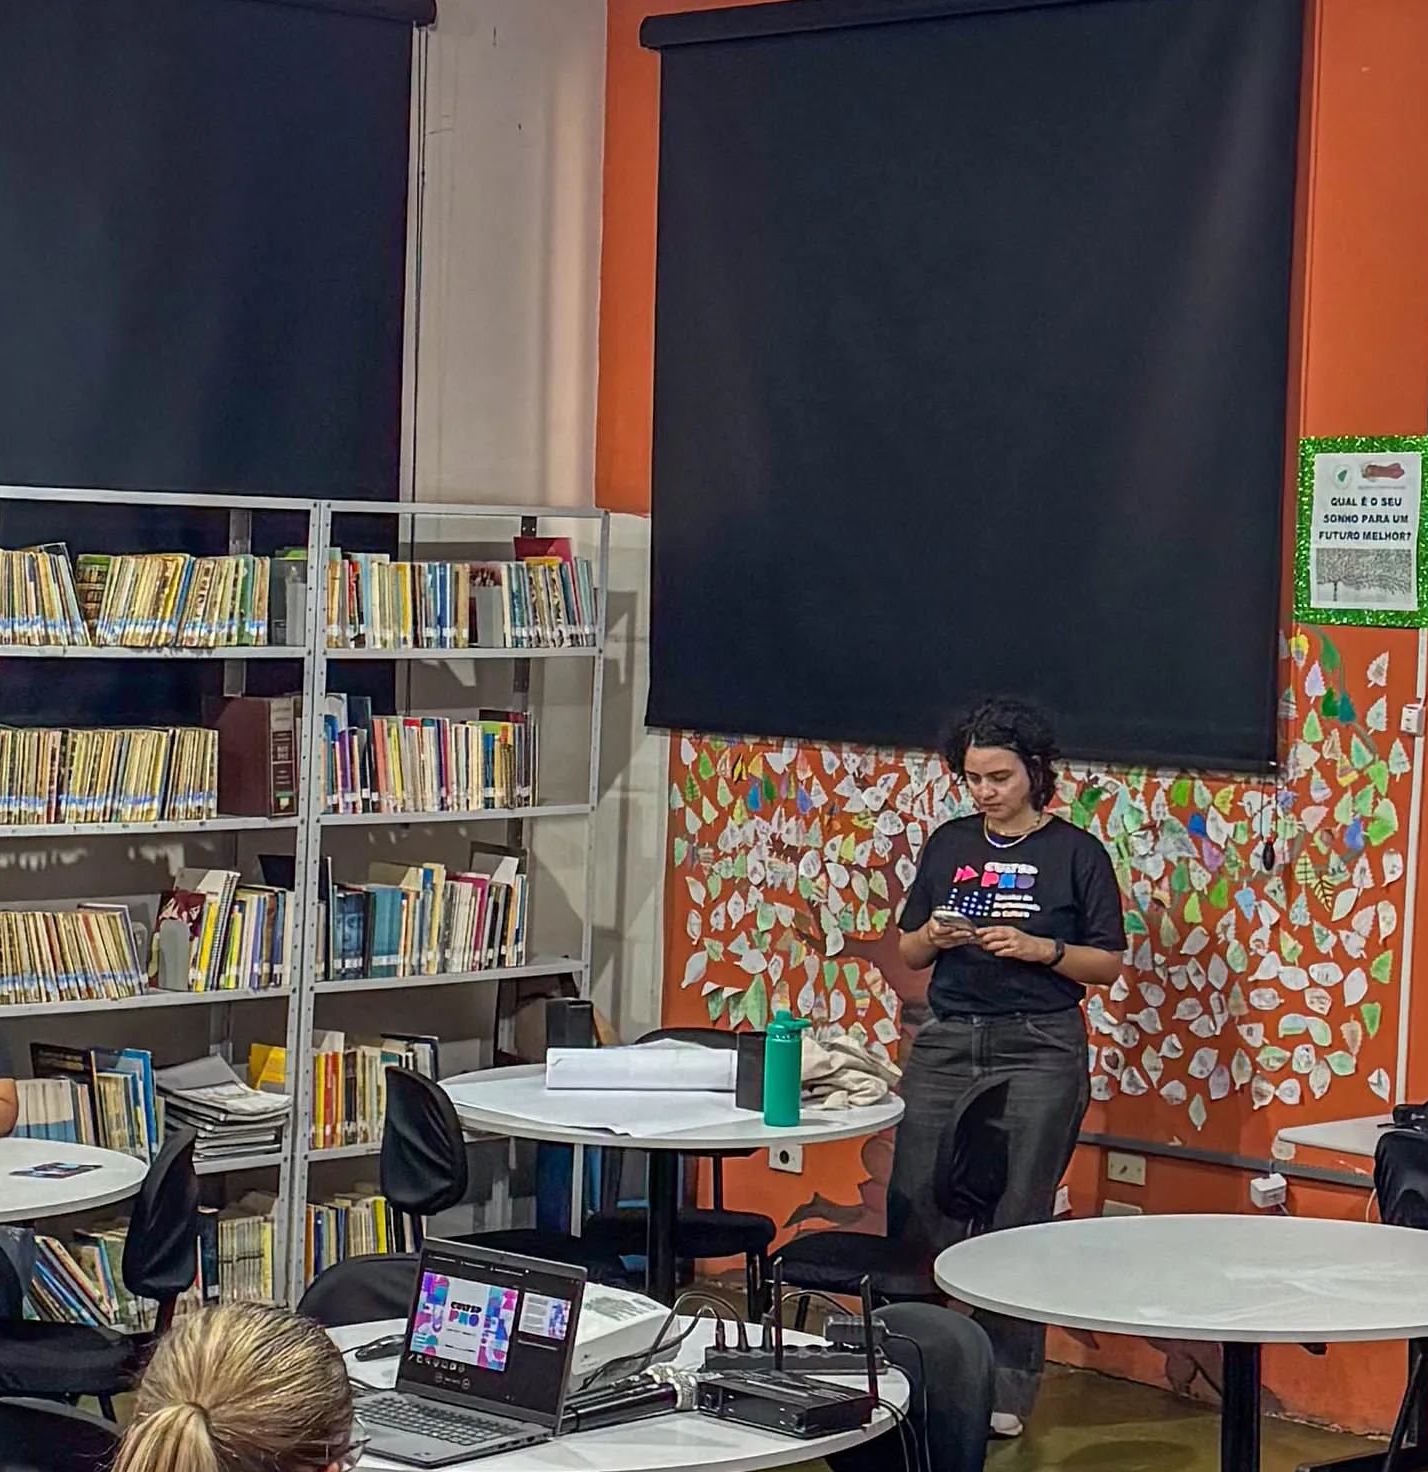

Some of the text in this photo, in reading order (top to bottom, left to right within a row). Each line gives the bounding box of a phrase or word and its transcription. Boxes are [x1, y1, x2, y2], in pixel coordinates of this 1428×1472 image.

[1330, 497, 1357, 507] QUAL
[1370, 497, 1378, 507] O
[1380, 497, 1402, 507] SEU
[1323, 514, 1409, 524] SONHO PARA UM
[1318, 530, 1412, 541] FUTURO MELHOR?
